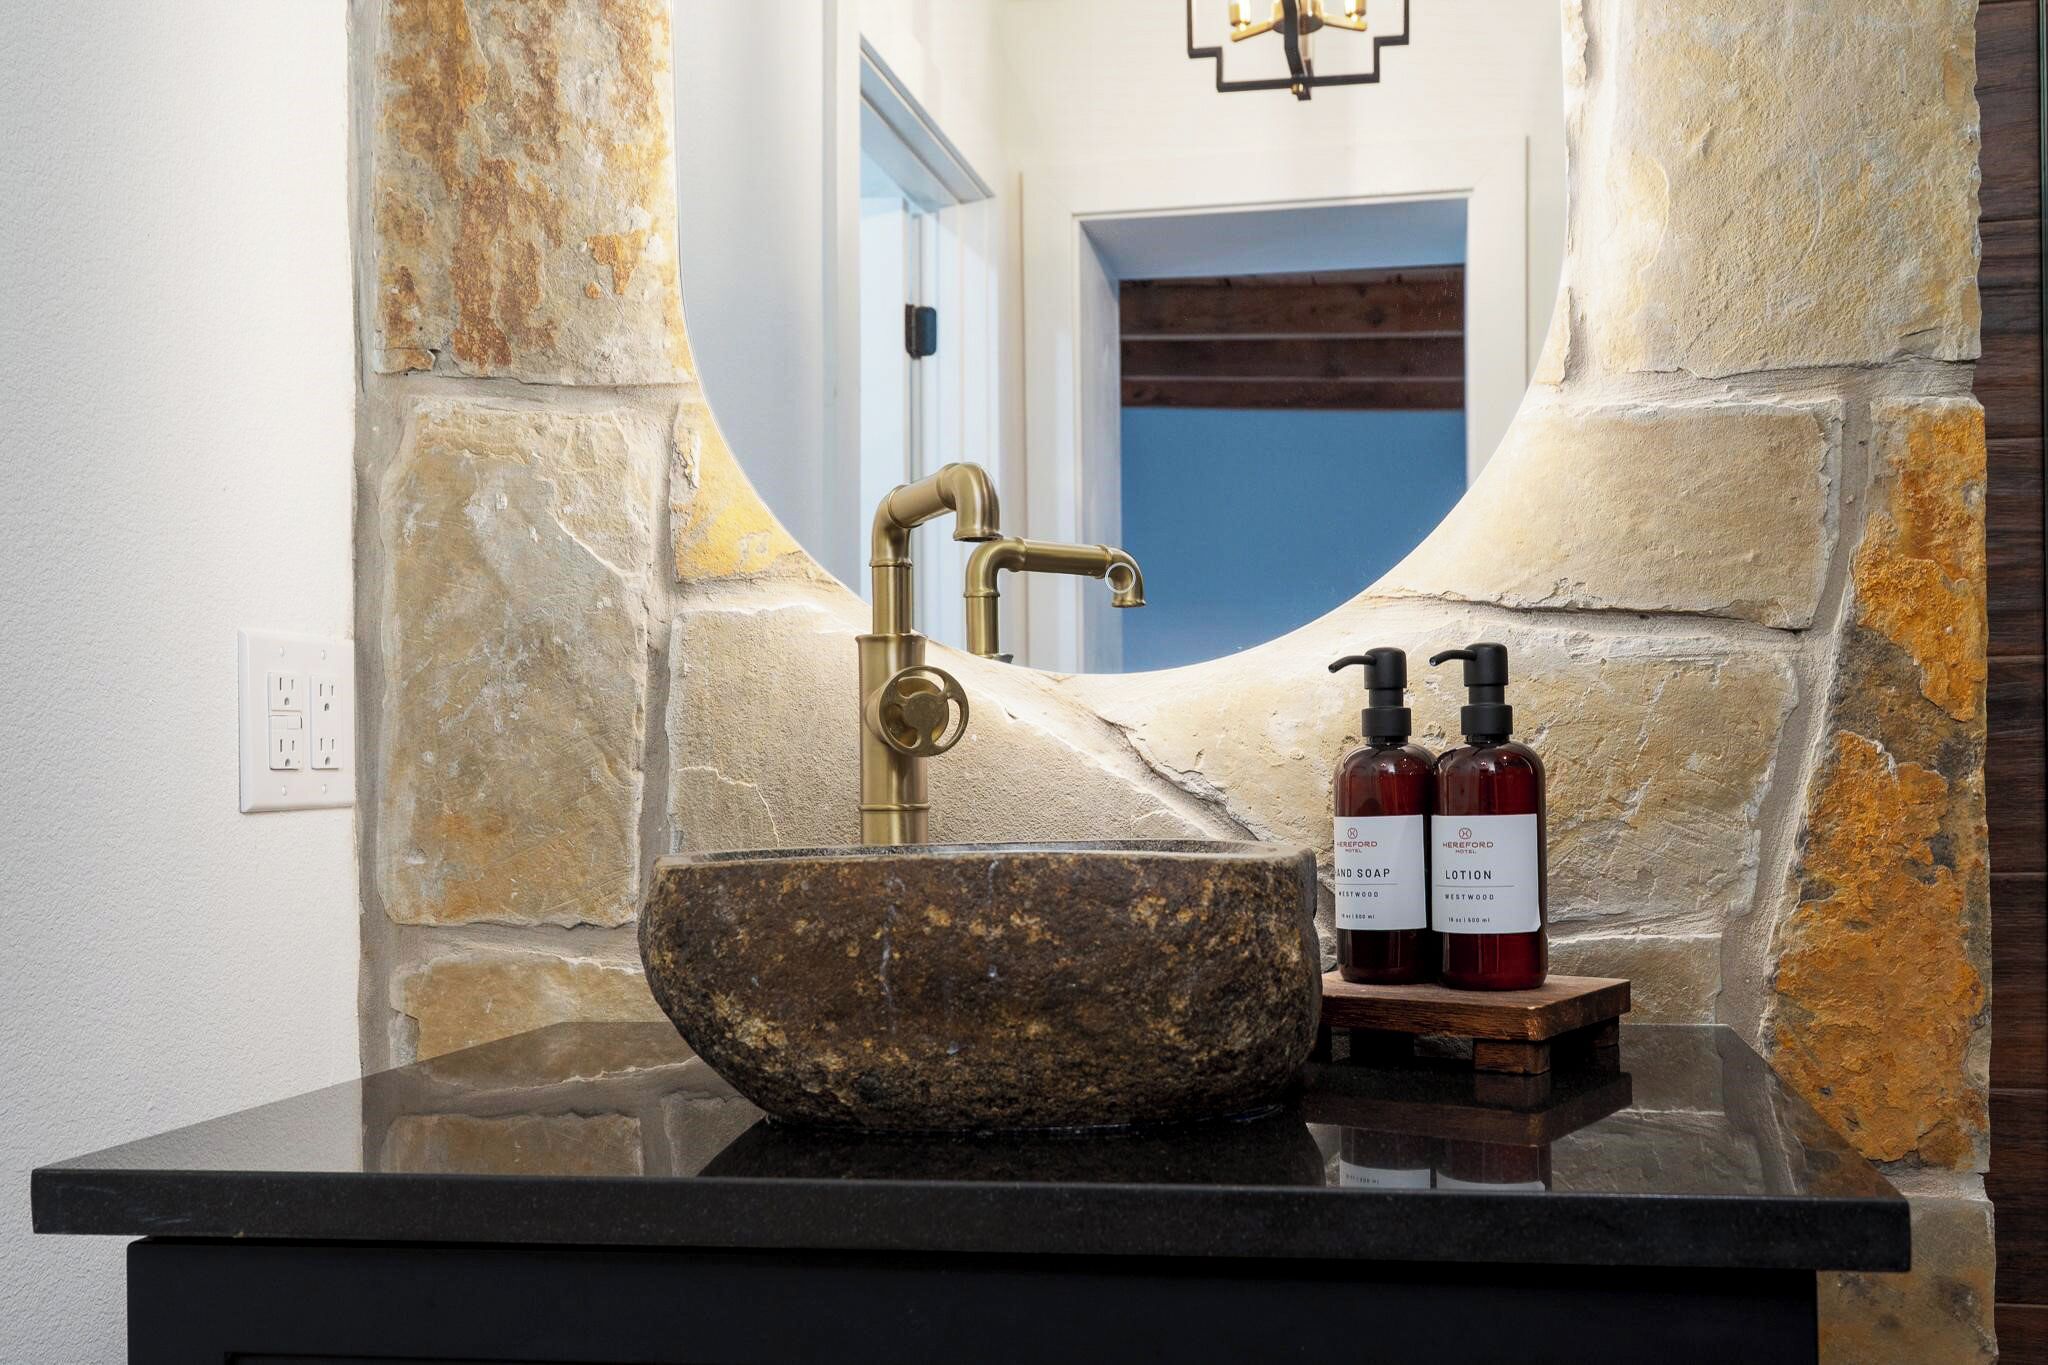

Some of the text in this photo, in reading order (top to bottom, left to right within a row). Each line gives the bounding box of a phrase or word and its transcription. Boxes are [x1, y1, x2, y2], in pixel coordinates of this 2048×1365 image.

[1336, 868, 1390, 878] AND SOAP
[1445, 869, 1491, 880] LOTION
